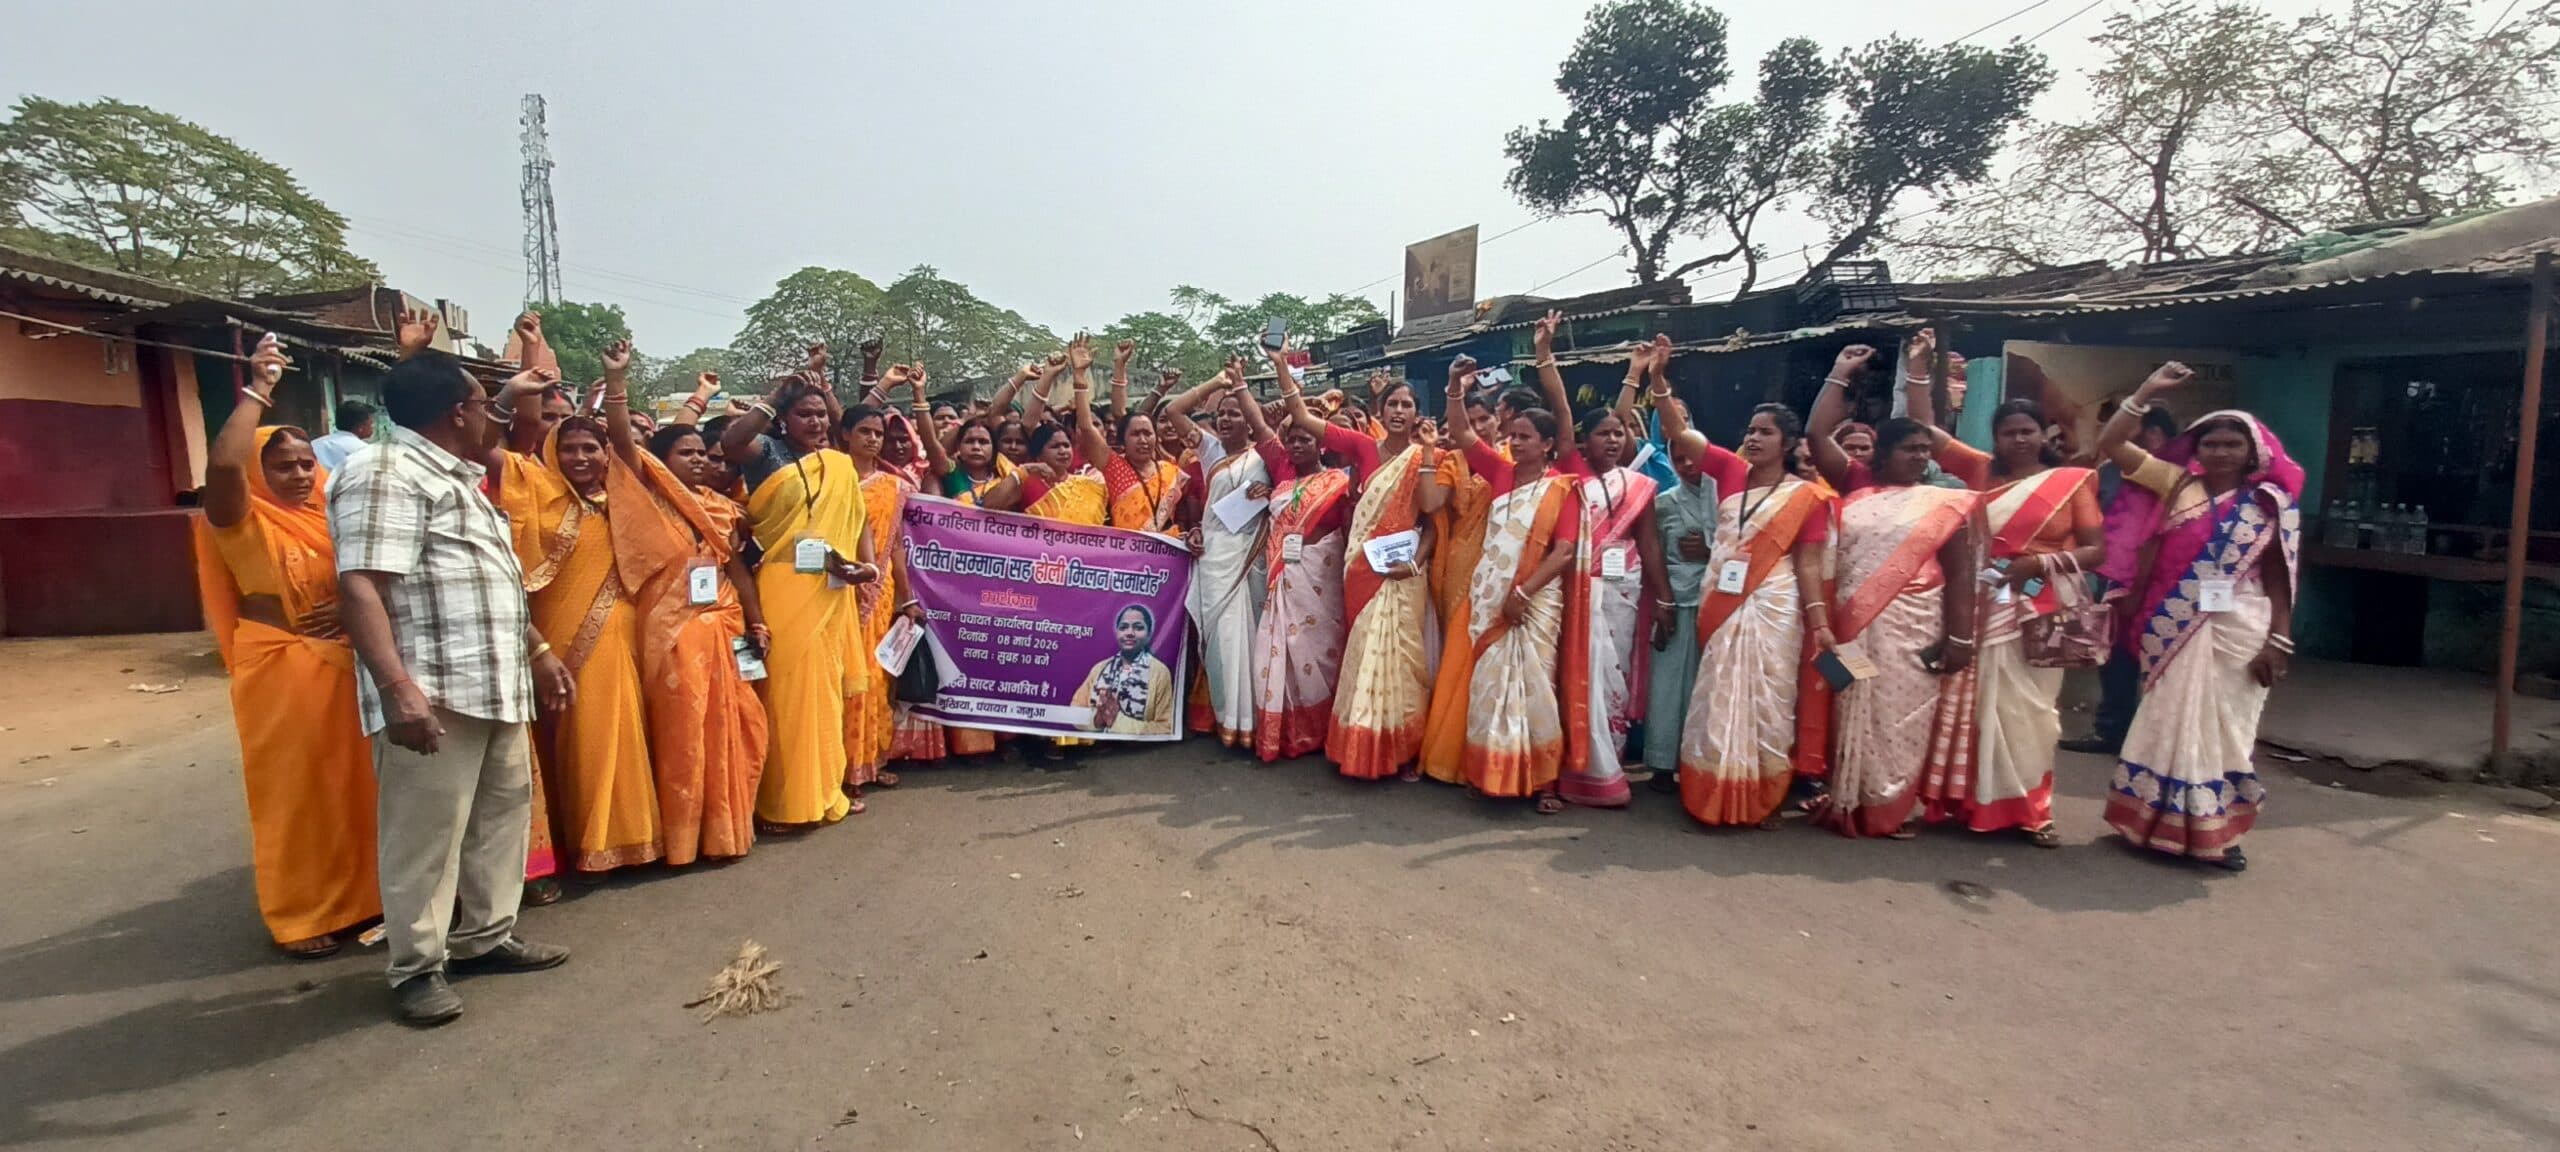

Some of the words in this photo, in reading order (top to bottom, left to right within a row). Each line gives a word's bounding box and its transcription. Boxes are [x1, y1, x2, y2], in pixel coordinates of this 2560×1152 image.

[938, 511, 980, 533] महिला
[984, 516, 1017, 537] दिवस
[1021, 522, 1040, 540] की
[1043, 528, 1107, 548] शुभअवसर
[1110, 534, 1128, 551] पर
[913, 539, 952, 571] शक्ति
[953, 550, 1008, 579] सम्मान
[1008, 557, 1034, 582] सह
[1034, 553, 1067, 584] होली
[1067, 557, 1111, 590] मिलन
[993, 615, 1034, 631] कार्यालय
[1035, 619, 1063, 634] परिसर
[1064, 624, 1093, 639] जमुआ
[997, 634, 1010, 646] 08
[1012, 635, 1032, 648] मार्च
[1033, 637, 1059, 651] 2026
[963, 647, 989, 659] समय
[997, 650, 1019, 665] सुबह
[1021, 654, 1032, 665] 10
[969, 677, 996, 692] सादर
[1016, 705, 1047, 719] जमुआ
